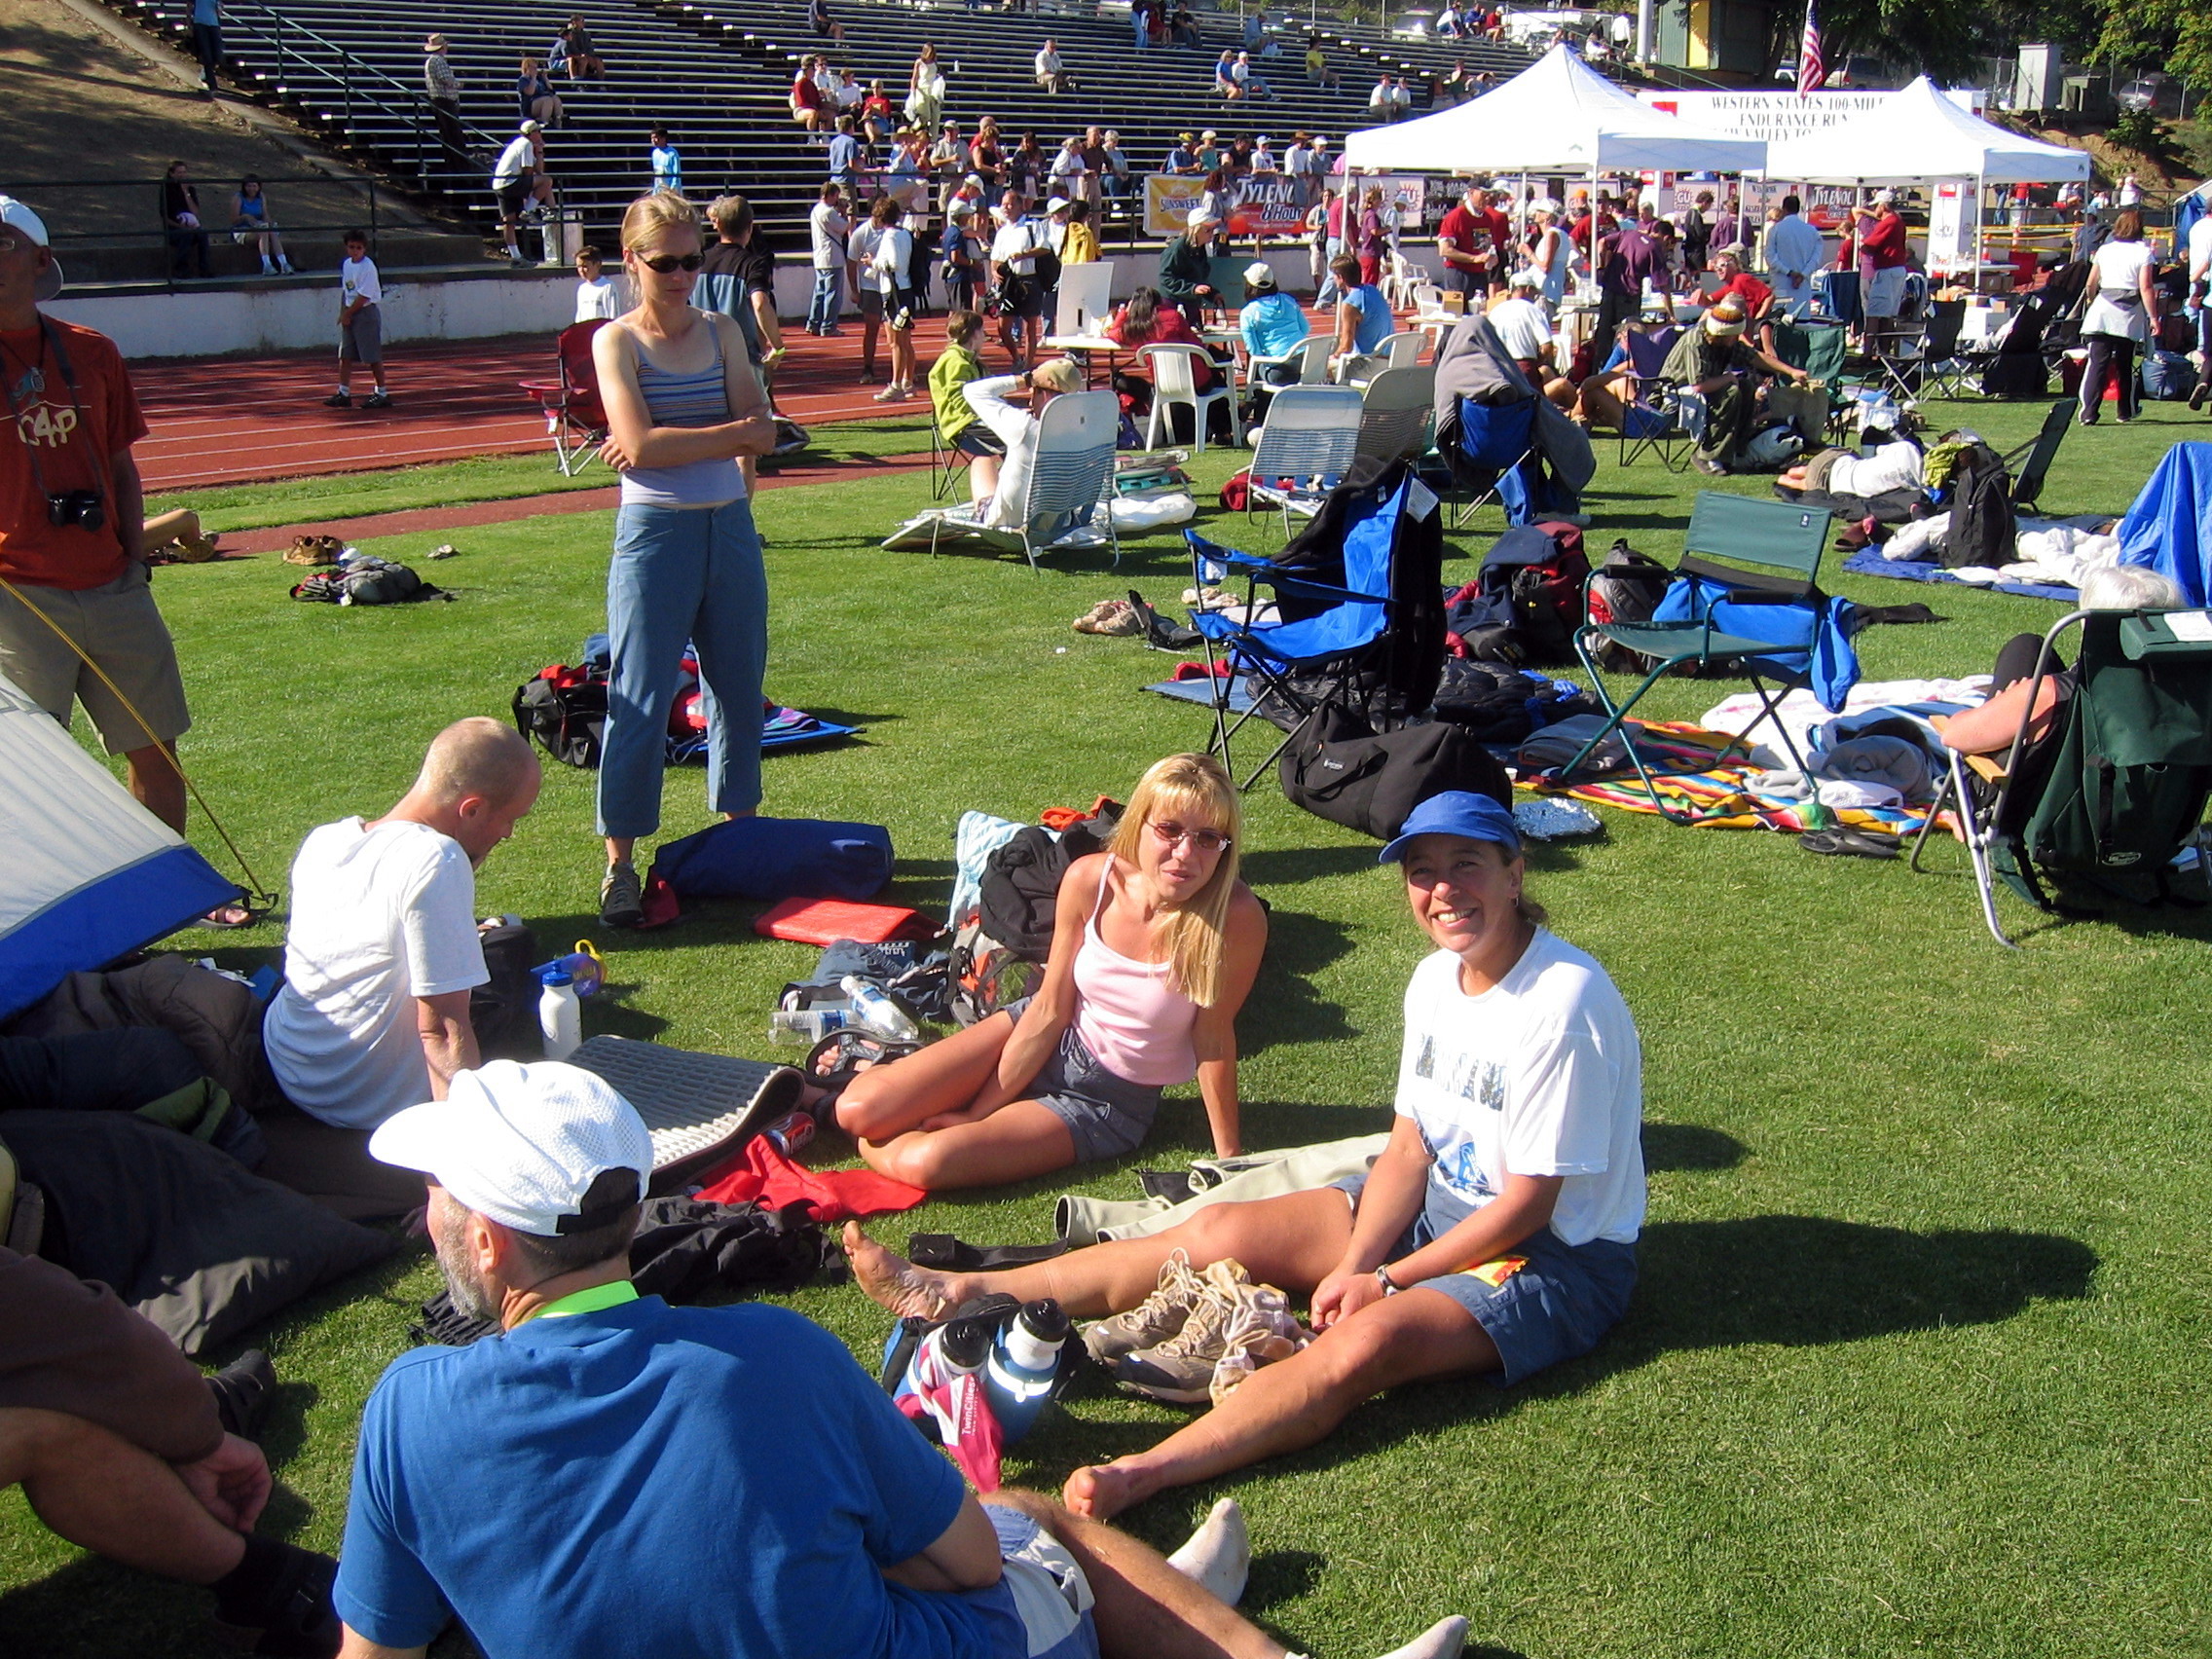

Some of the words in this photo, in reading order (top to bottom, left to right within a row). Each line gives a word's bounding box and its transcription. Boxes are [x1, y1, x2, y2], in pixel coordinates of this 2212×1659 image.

[1712, 96, 1769, 109] WESTERN
[1777, 96, 1823, 110] STATES
[1740, 113, 1817, 127] ENDURANCE
[1235, 176, 1295, 203] TYLENO
[1814, 186, 1853, 205] TYLENOL
[1677, 193, 1691, 203] GU
[1261, 203, 1272, 221] 8
[1272, 205, 1305, 221] Hour
